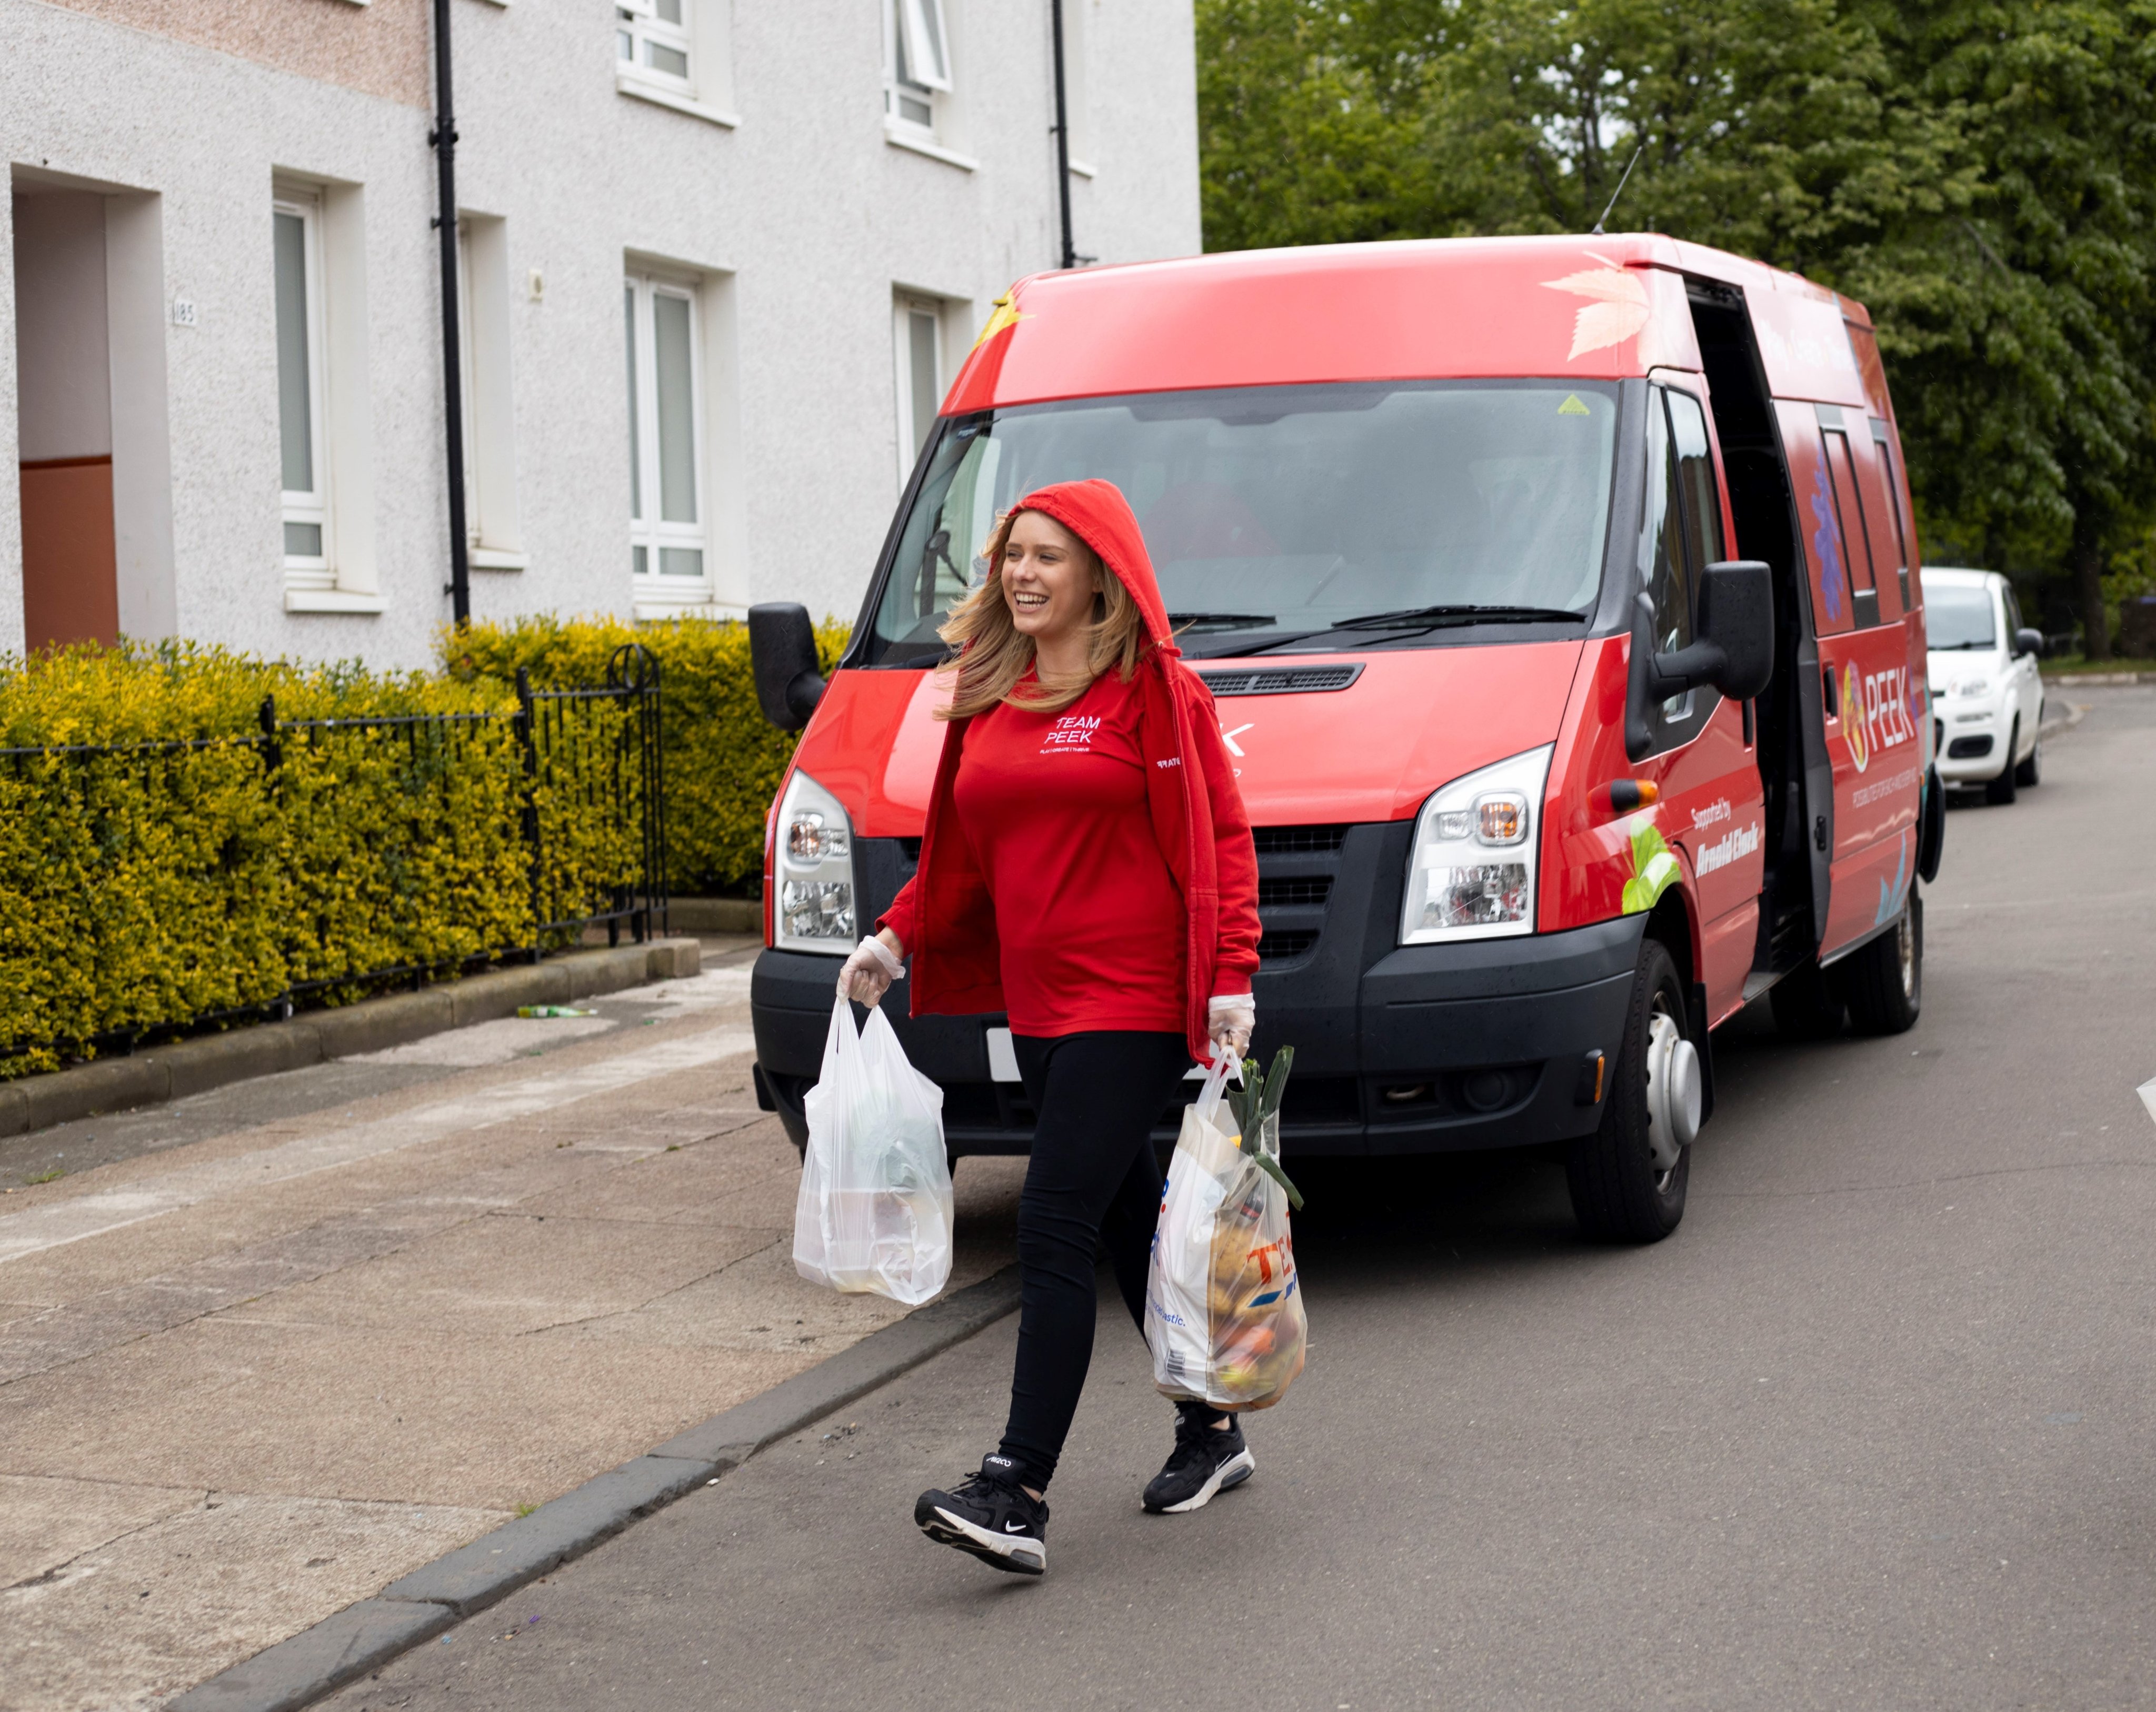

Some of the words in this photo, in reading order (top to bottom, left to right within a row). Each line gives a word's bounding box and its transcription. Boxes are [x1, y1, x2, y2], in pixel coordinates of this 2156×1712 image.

[1056, 716, 1101, 729] TEAM
[1865, 665, 1914, 752] PEEK
[1044, 730, 1093, 744] PEEK
[1691, 798, 1723, 832] Supported
[1720, 797, 1731, 821] by
[1695, 831, 1733, 879] Arnold
[1732, 821, 1759, 861] Clark
